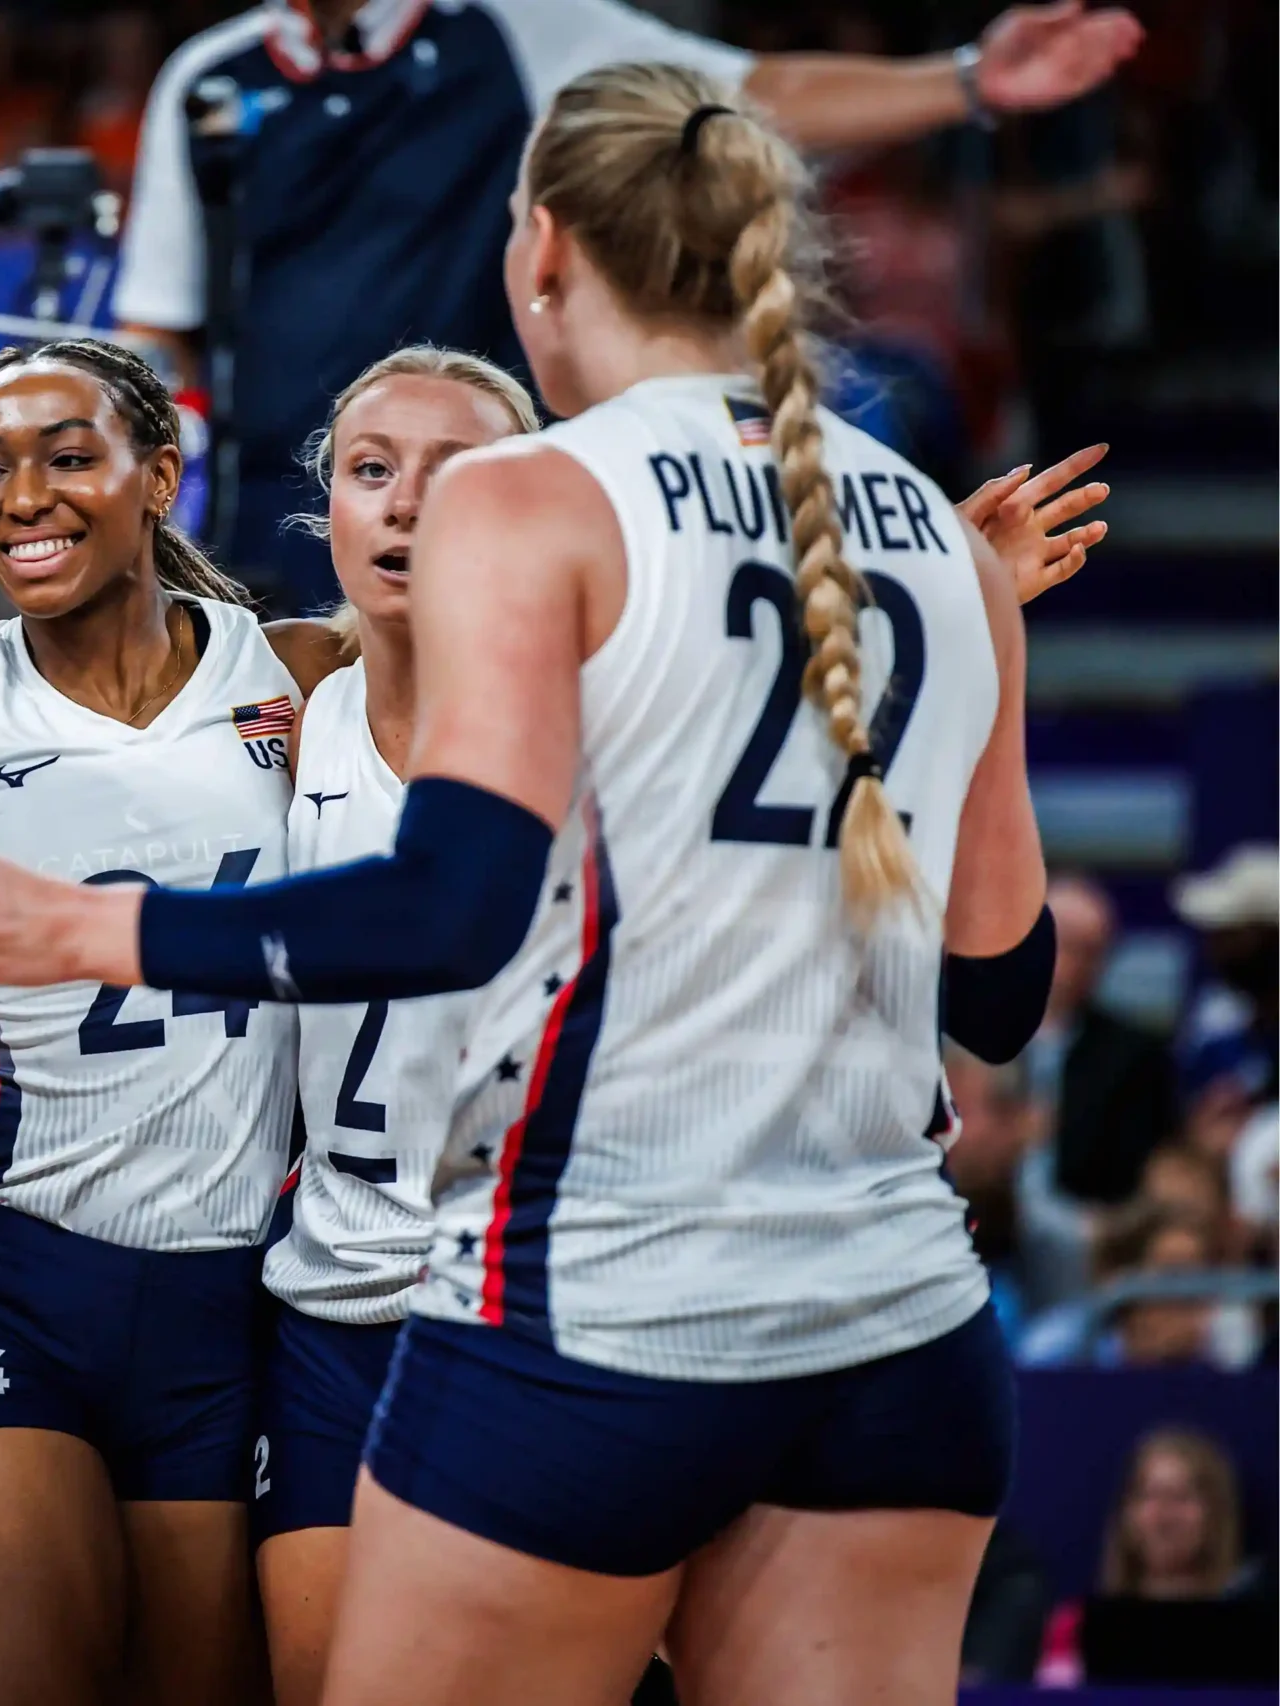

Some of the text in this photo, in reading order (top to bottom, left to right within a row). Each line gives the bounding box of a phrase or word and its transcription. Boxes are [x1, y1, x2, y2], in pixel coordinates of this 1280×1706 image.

[710, 558, 927, 849] 22
[243, 737, 290, 770] US
[254, 1434, 271, 1500] 2
